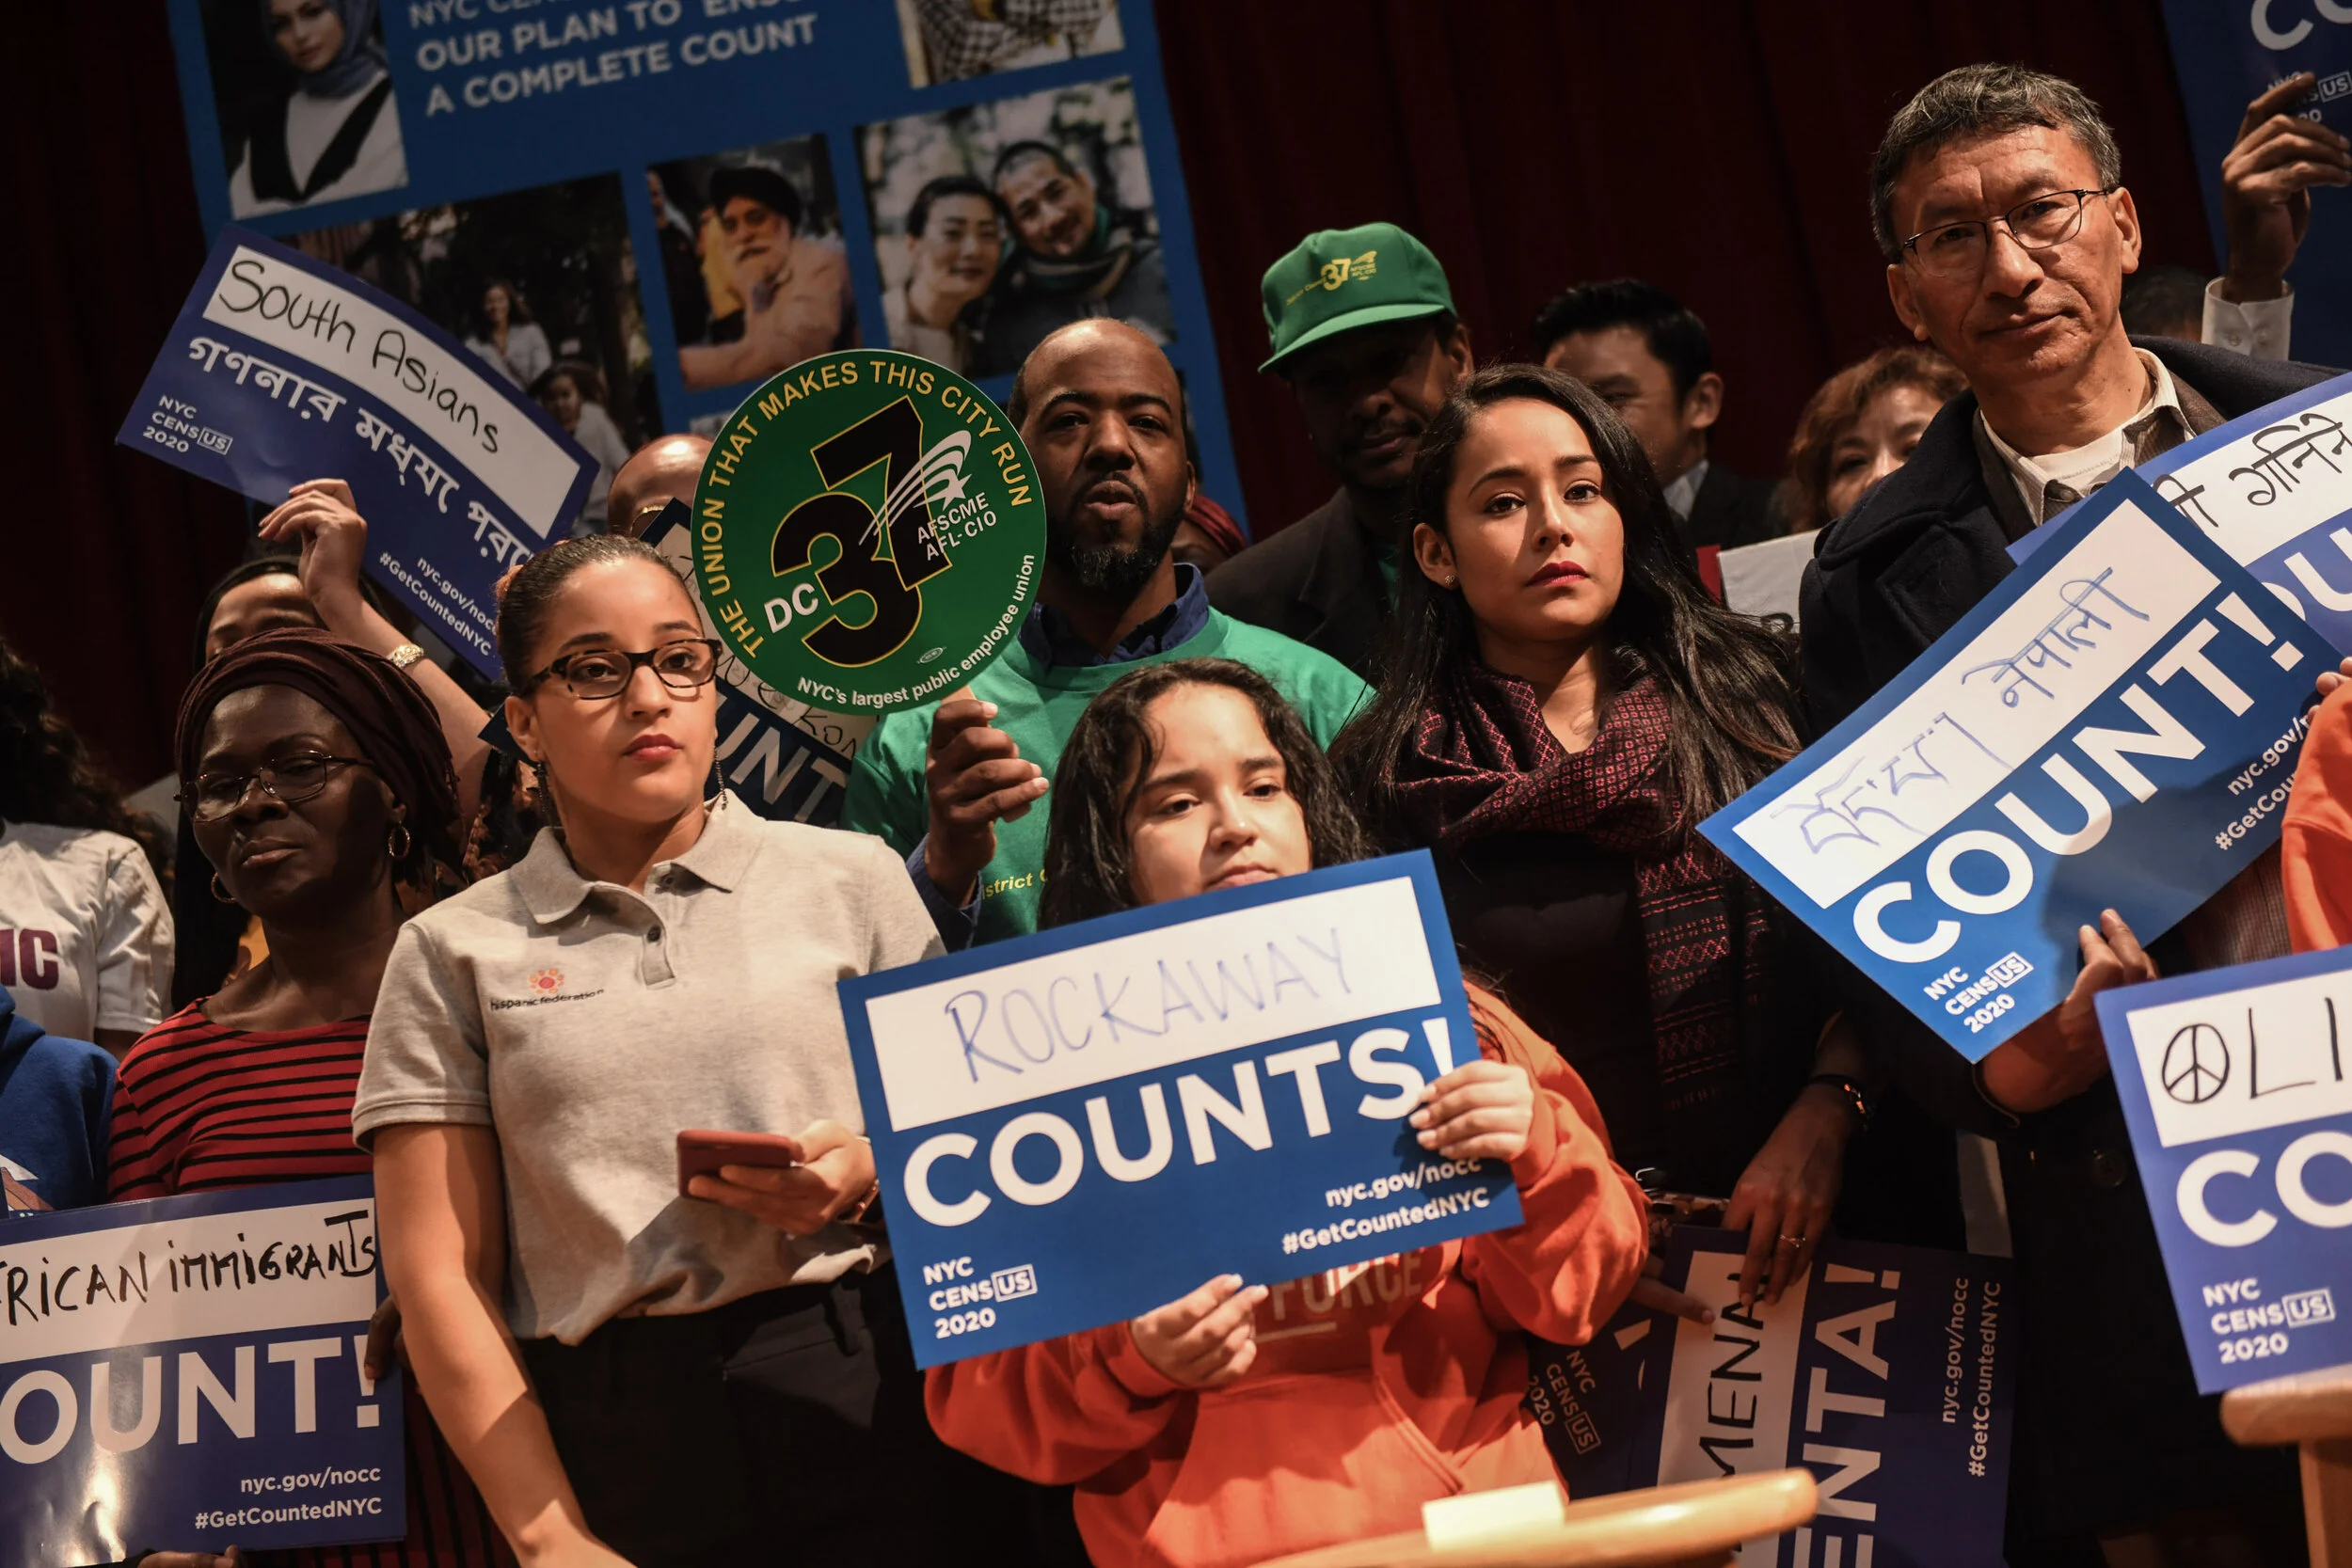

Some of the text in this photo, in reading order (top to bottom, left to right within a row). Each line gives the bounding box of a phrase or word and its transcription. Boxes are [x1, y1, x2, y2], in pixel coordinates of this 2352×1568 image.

[415, 29, 503, 71] OUR
[512, 7, 618, 54] PLAN
[624, 0, 682, 31] TO
[425, 13, 818, 118] A COMPLETE COUNT
[1320, 258, 1352, 292] 37
[218, 260, 500, 454] South Asians
[151, 410, 233, 455] CENSUS
[159, 395, 197, 420] NYC
[143, 426, 189, 453] 2020
[701, 361, 1033, 658] THE UNION THAT MAKES THIS CITY RUN
[763, 395, 953, 668] DC 37
[916, 492, 990, 545] AFSCME
[925, 510, 997, 562] AFL-CIO
[379, 552, 493, 657] #GetCountedNYC
[797, 676, 848, 705] NYC's
[851, 688, 910, 709] largest
[912, 665, 961, 701] public
[960, 604, 1019, 672] employee
[1011, 553, 1035, 603] union
[1961, 567, 2150, 707] नेपाली
[716, 692, 848, 823] UNT
[1852, 592, 2305, 963] COUNT!
[2216, 771, 2297, 850] #GetCou
[981, 873, 1033, 899] istrict
[944, 927, 1353, 1083] ROCKAWAY
[1923, 965, 1969, 1001] NYC
[1944, 951, 2034, 1017] CENSUS
[1963, 992, 2016, 1033] 2020
[903, 1016, 1456, 1227] COUNTS!
[1325, 1158, 1482, 1208] nyc.gov/nocc
[1281, 1186, 1490, 1255] #GetCountedNYC
[924, 1256, 974, 1287] NYC
[929, 1263, 1038, 1312] CENSUS
[2202, 1277, 2260, 1307] NYC
[934, 1308, 997, 1338] 2020
[2211, 1287, 2335, 1335] CENSUS
[1566, 1349, 1596, 1394] NYC
[1942, 1277, 1970, 1425] nyc.gov/nocc
[2218, 1332, 2289, 1364] 2020
[1969, 1281, 2001, 1478] #GetCountedNYC
[1546, 1363, 1601, 1454] CENSUS
[240, 1465, 382, 1496] nyc.gov/nocc
[195, 1496, 383, 1529] #GetCountedNYC
